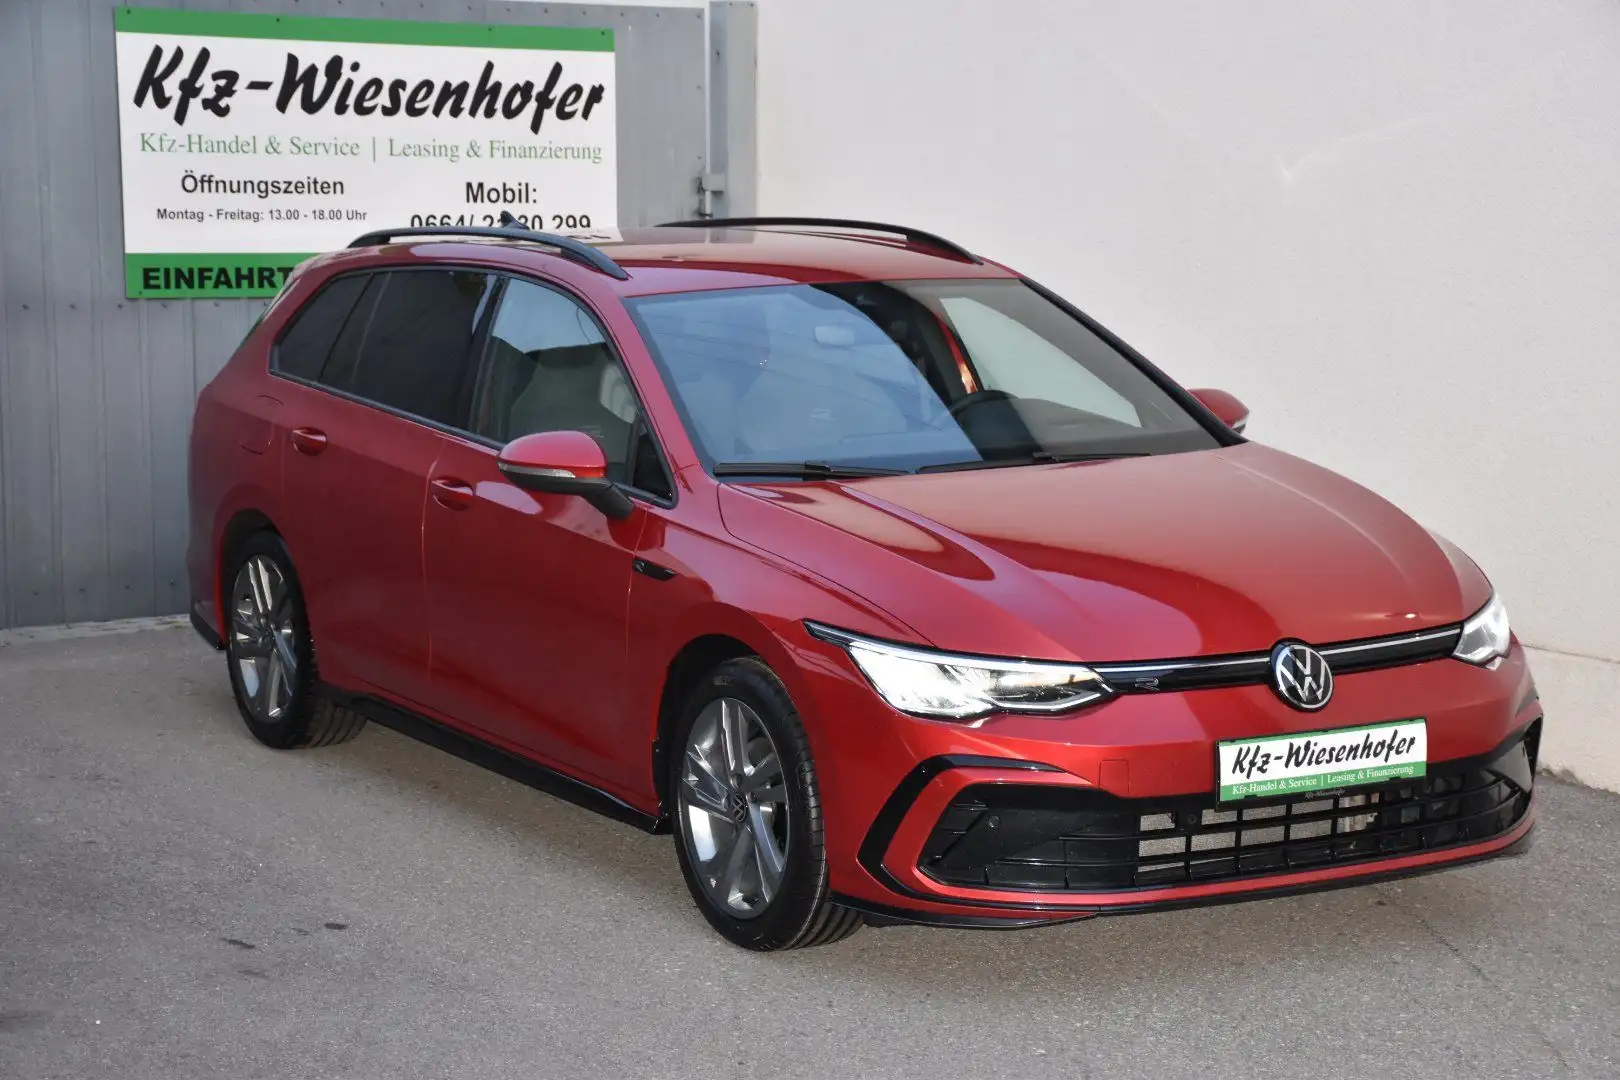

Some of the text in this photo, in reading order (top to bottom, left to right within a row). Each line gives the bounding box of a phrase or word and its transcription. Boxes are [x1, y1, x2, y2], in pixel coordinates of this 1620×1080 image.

[133, 44, 605, 135] Kfz-Wiesenhofer
[141, 133, 257, 154] Kfz-Handel
[265, 136, 282, 155] &
[290, 137, 359, 156] Service
[390, 138, 459, 162] Leasing
[467, 140, 480, 158] &
[490, 140, 601, 164] Finanzierung
[181, 170, 344, 199] Öffnungszeiten
[466, 182, 536, 204] Mobil:
[157, 208, 204, 222] Montag
[217, 209, 263, 223] Freitag:
[268, 209, 299, 220] 13.00
[312, 209, 342, 220] 18.00
[346, 210, 367, 220] Uhr
[143, 267, 294, 290] EINFAHRT
[1232, 729, 1416, 779] Kfz-Wiesenhofer
[1288, 777, 1317, 788] Service
[1327, 772, 1356, 783] Leasing
